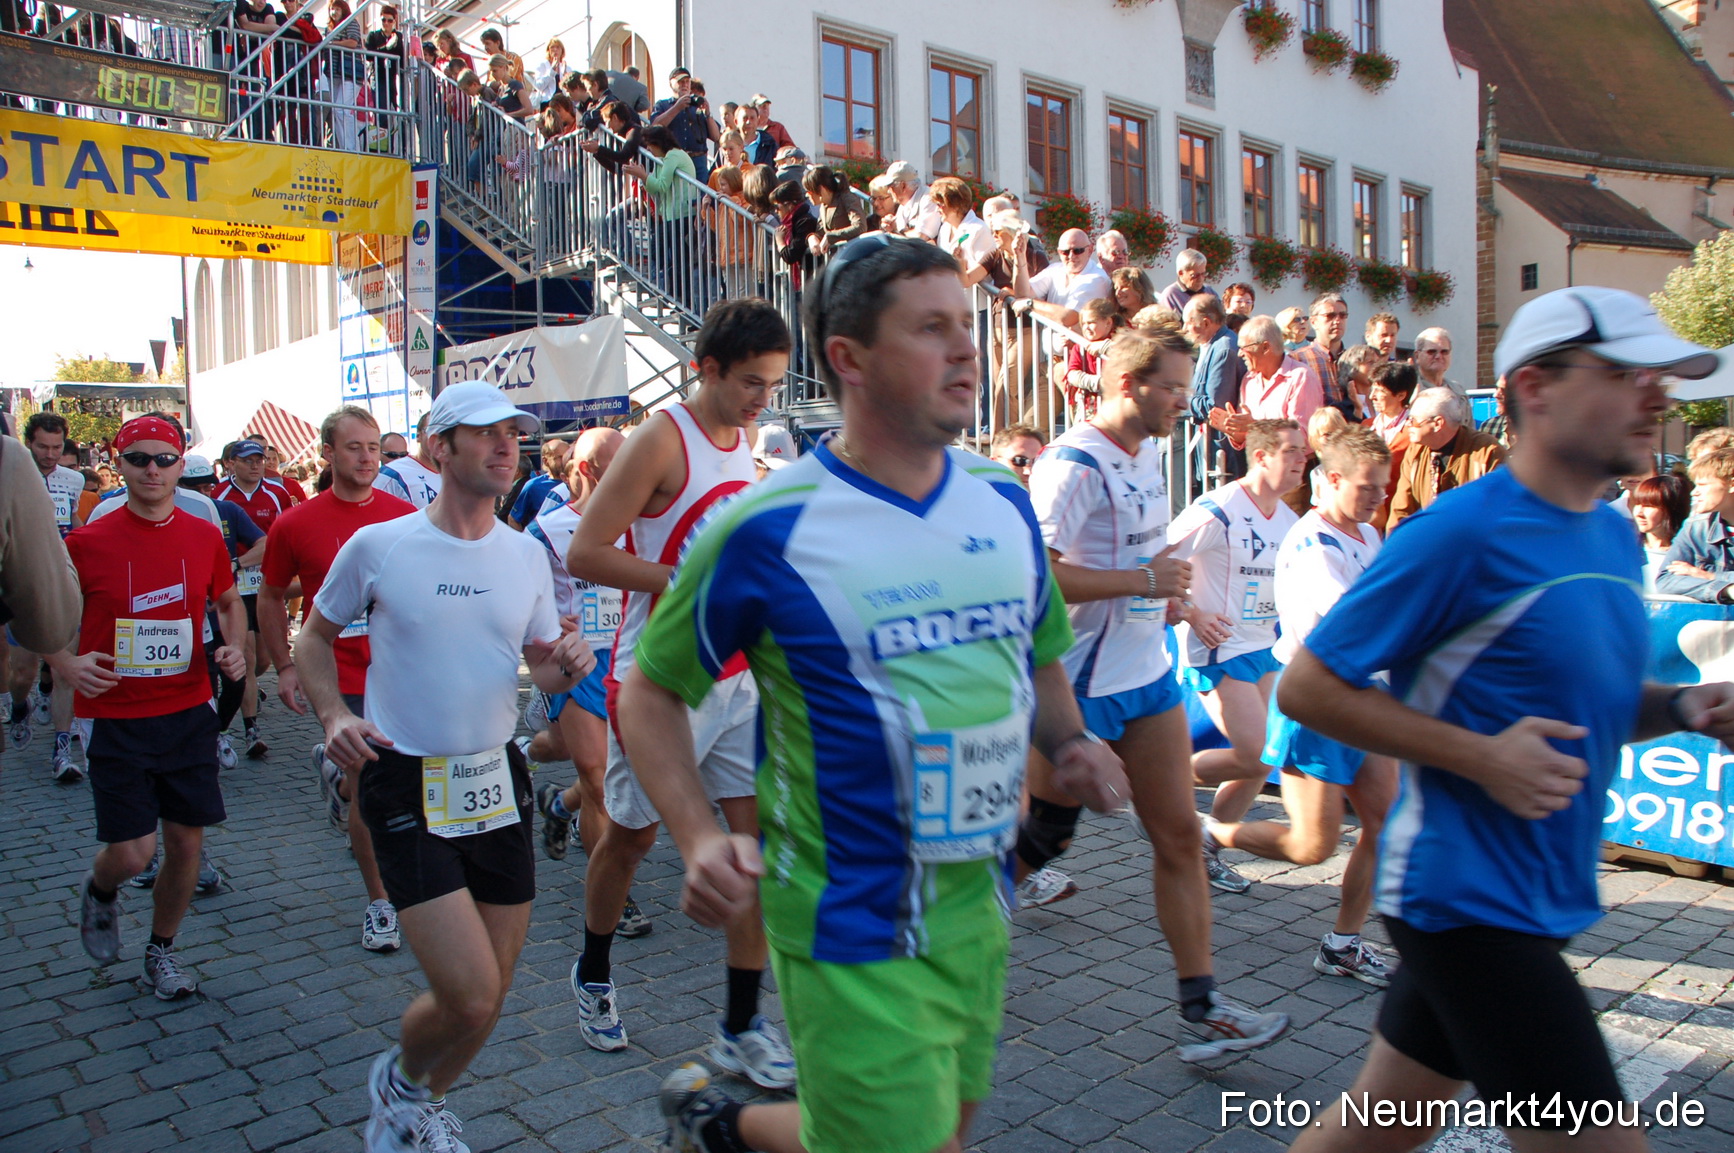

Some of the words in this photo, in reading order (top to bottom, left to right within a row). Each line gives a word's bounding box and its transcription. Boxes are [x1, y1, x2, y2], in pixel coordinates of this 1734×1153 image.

[53, 48, 114, 65] Elektronische
[117, 58, 218, 83] Sportstätteneinrichtungen
[251, 187, 324, 204] Neumarkter
[326, 194, 379, 209] Stadtlauf
[147, 592, 170, 605] DEHN
[436, 584, 471, 597] RUN
[137, 625, 179, 637] Andreas
[868, 597, 1025, 661] BOCK
[118, 641, 124, 650] C
[144, 643, 182, 661] 304
[452, 757, 502, 779] Alexander
[428, 789, 435, 801] B
[463, 784, 502, 812] 333
